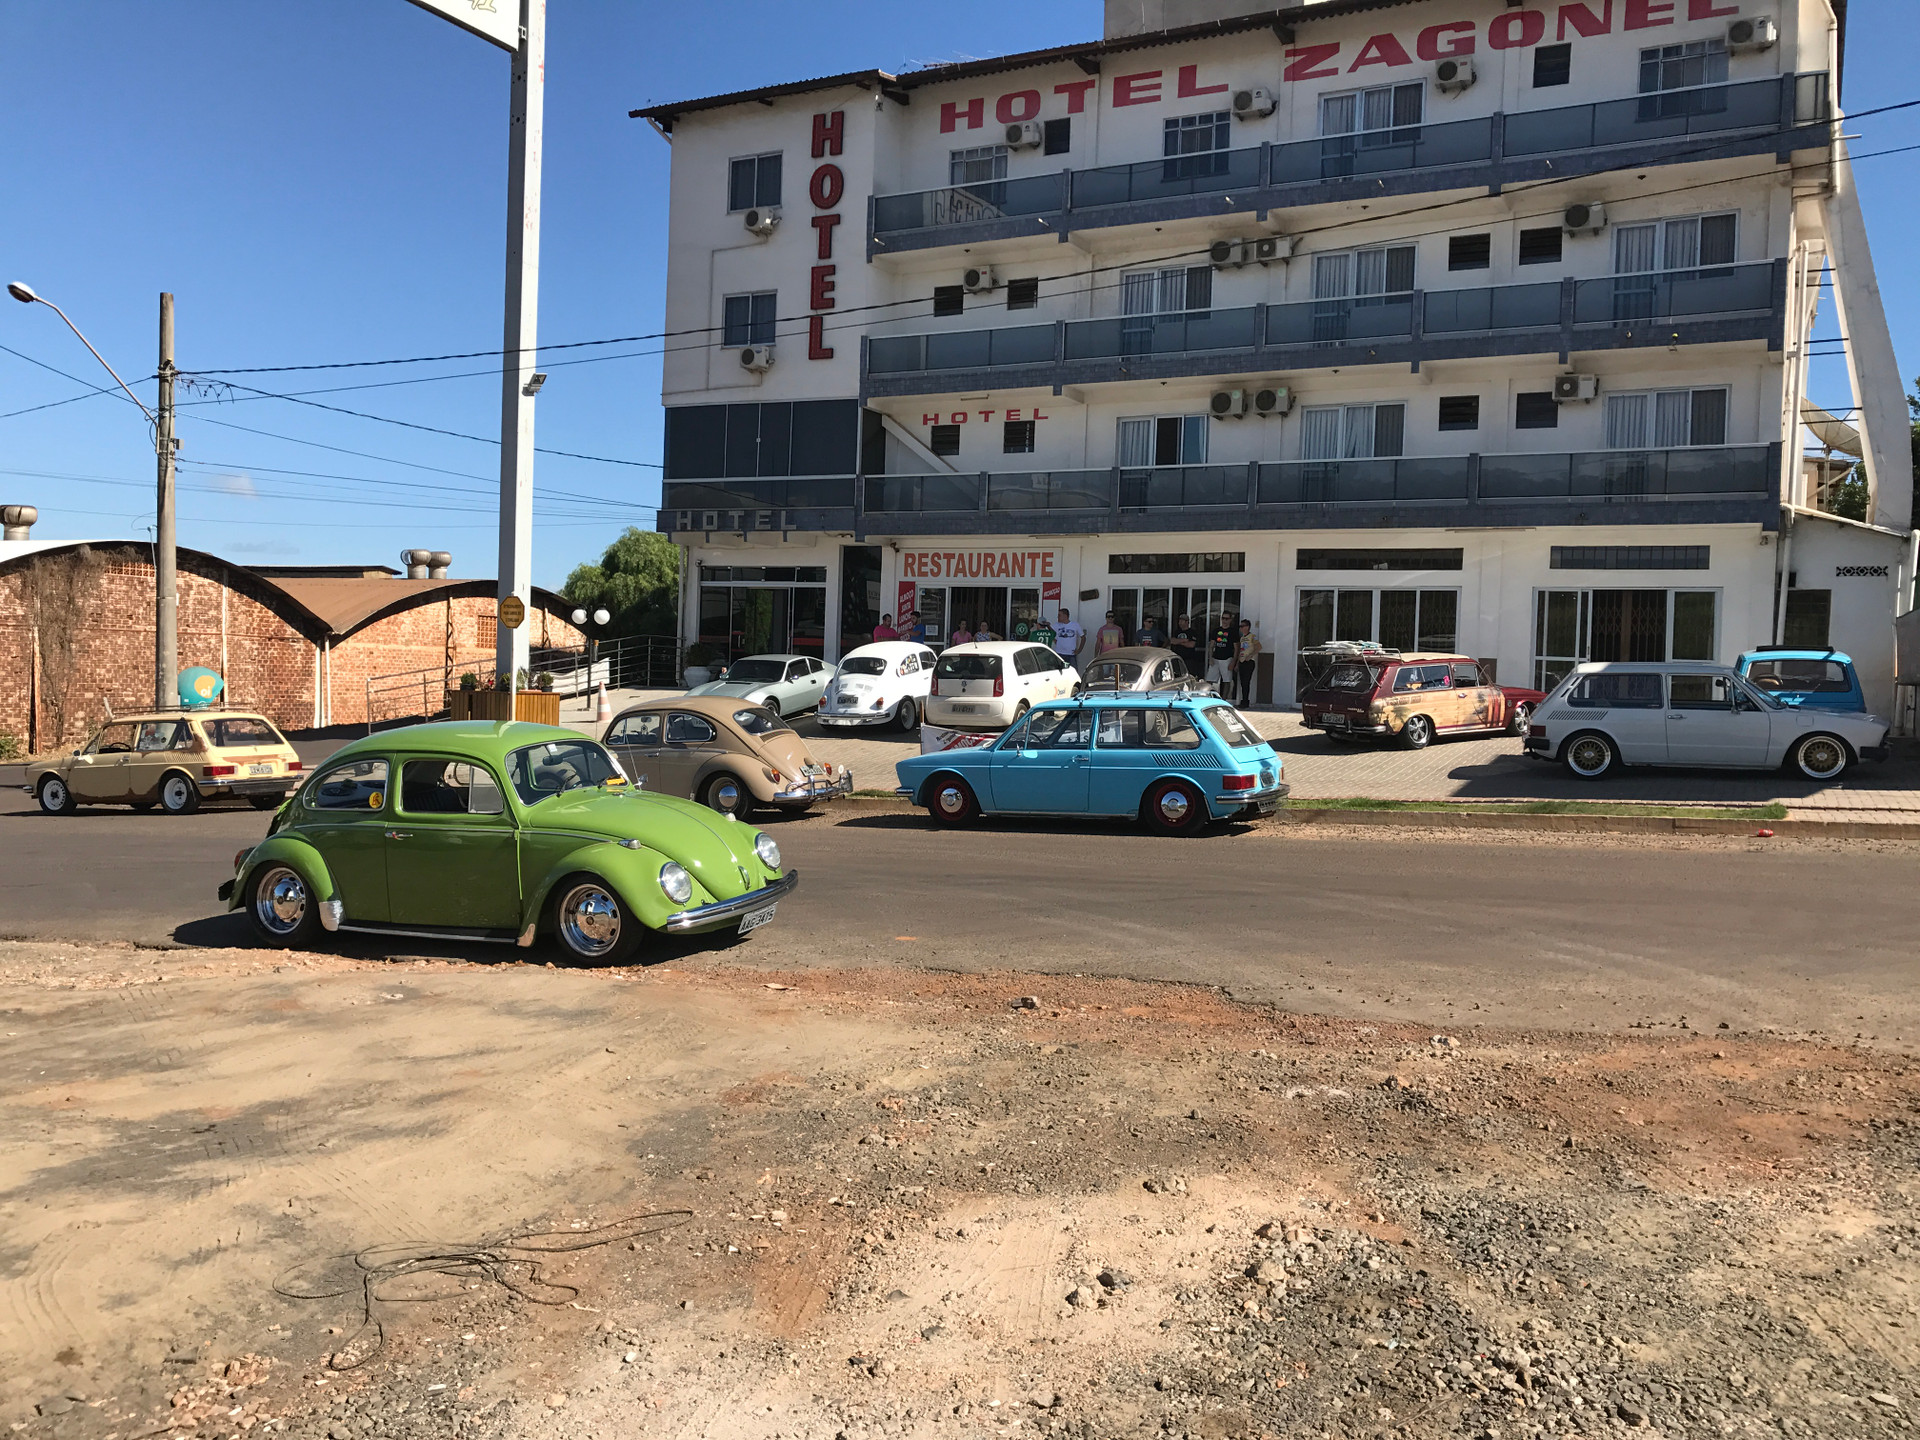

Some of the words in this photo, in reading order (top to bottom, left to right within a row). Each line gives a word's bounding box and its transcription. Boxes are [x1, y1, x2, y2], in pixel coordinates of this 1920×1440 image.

[939, 66, 1229, 134] HOTEL
[1284, 0, 1739, 82] ZAGONEL
[808, 110, 845, 360] HOTEL
[922, 408, 1049, 426] HOTEL
[676, 510, 797, 530] HOTEL
[903, 552, 1054, 578] RESTAURANTE
